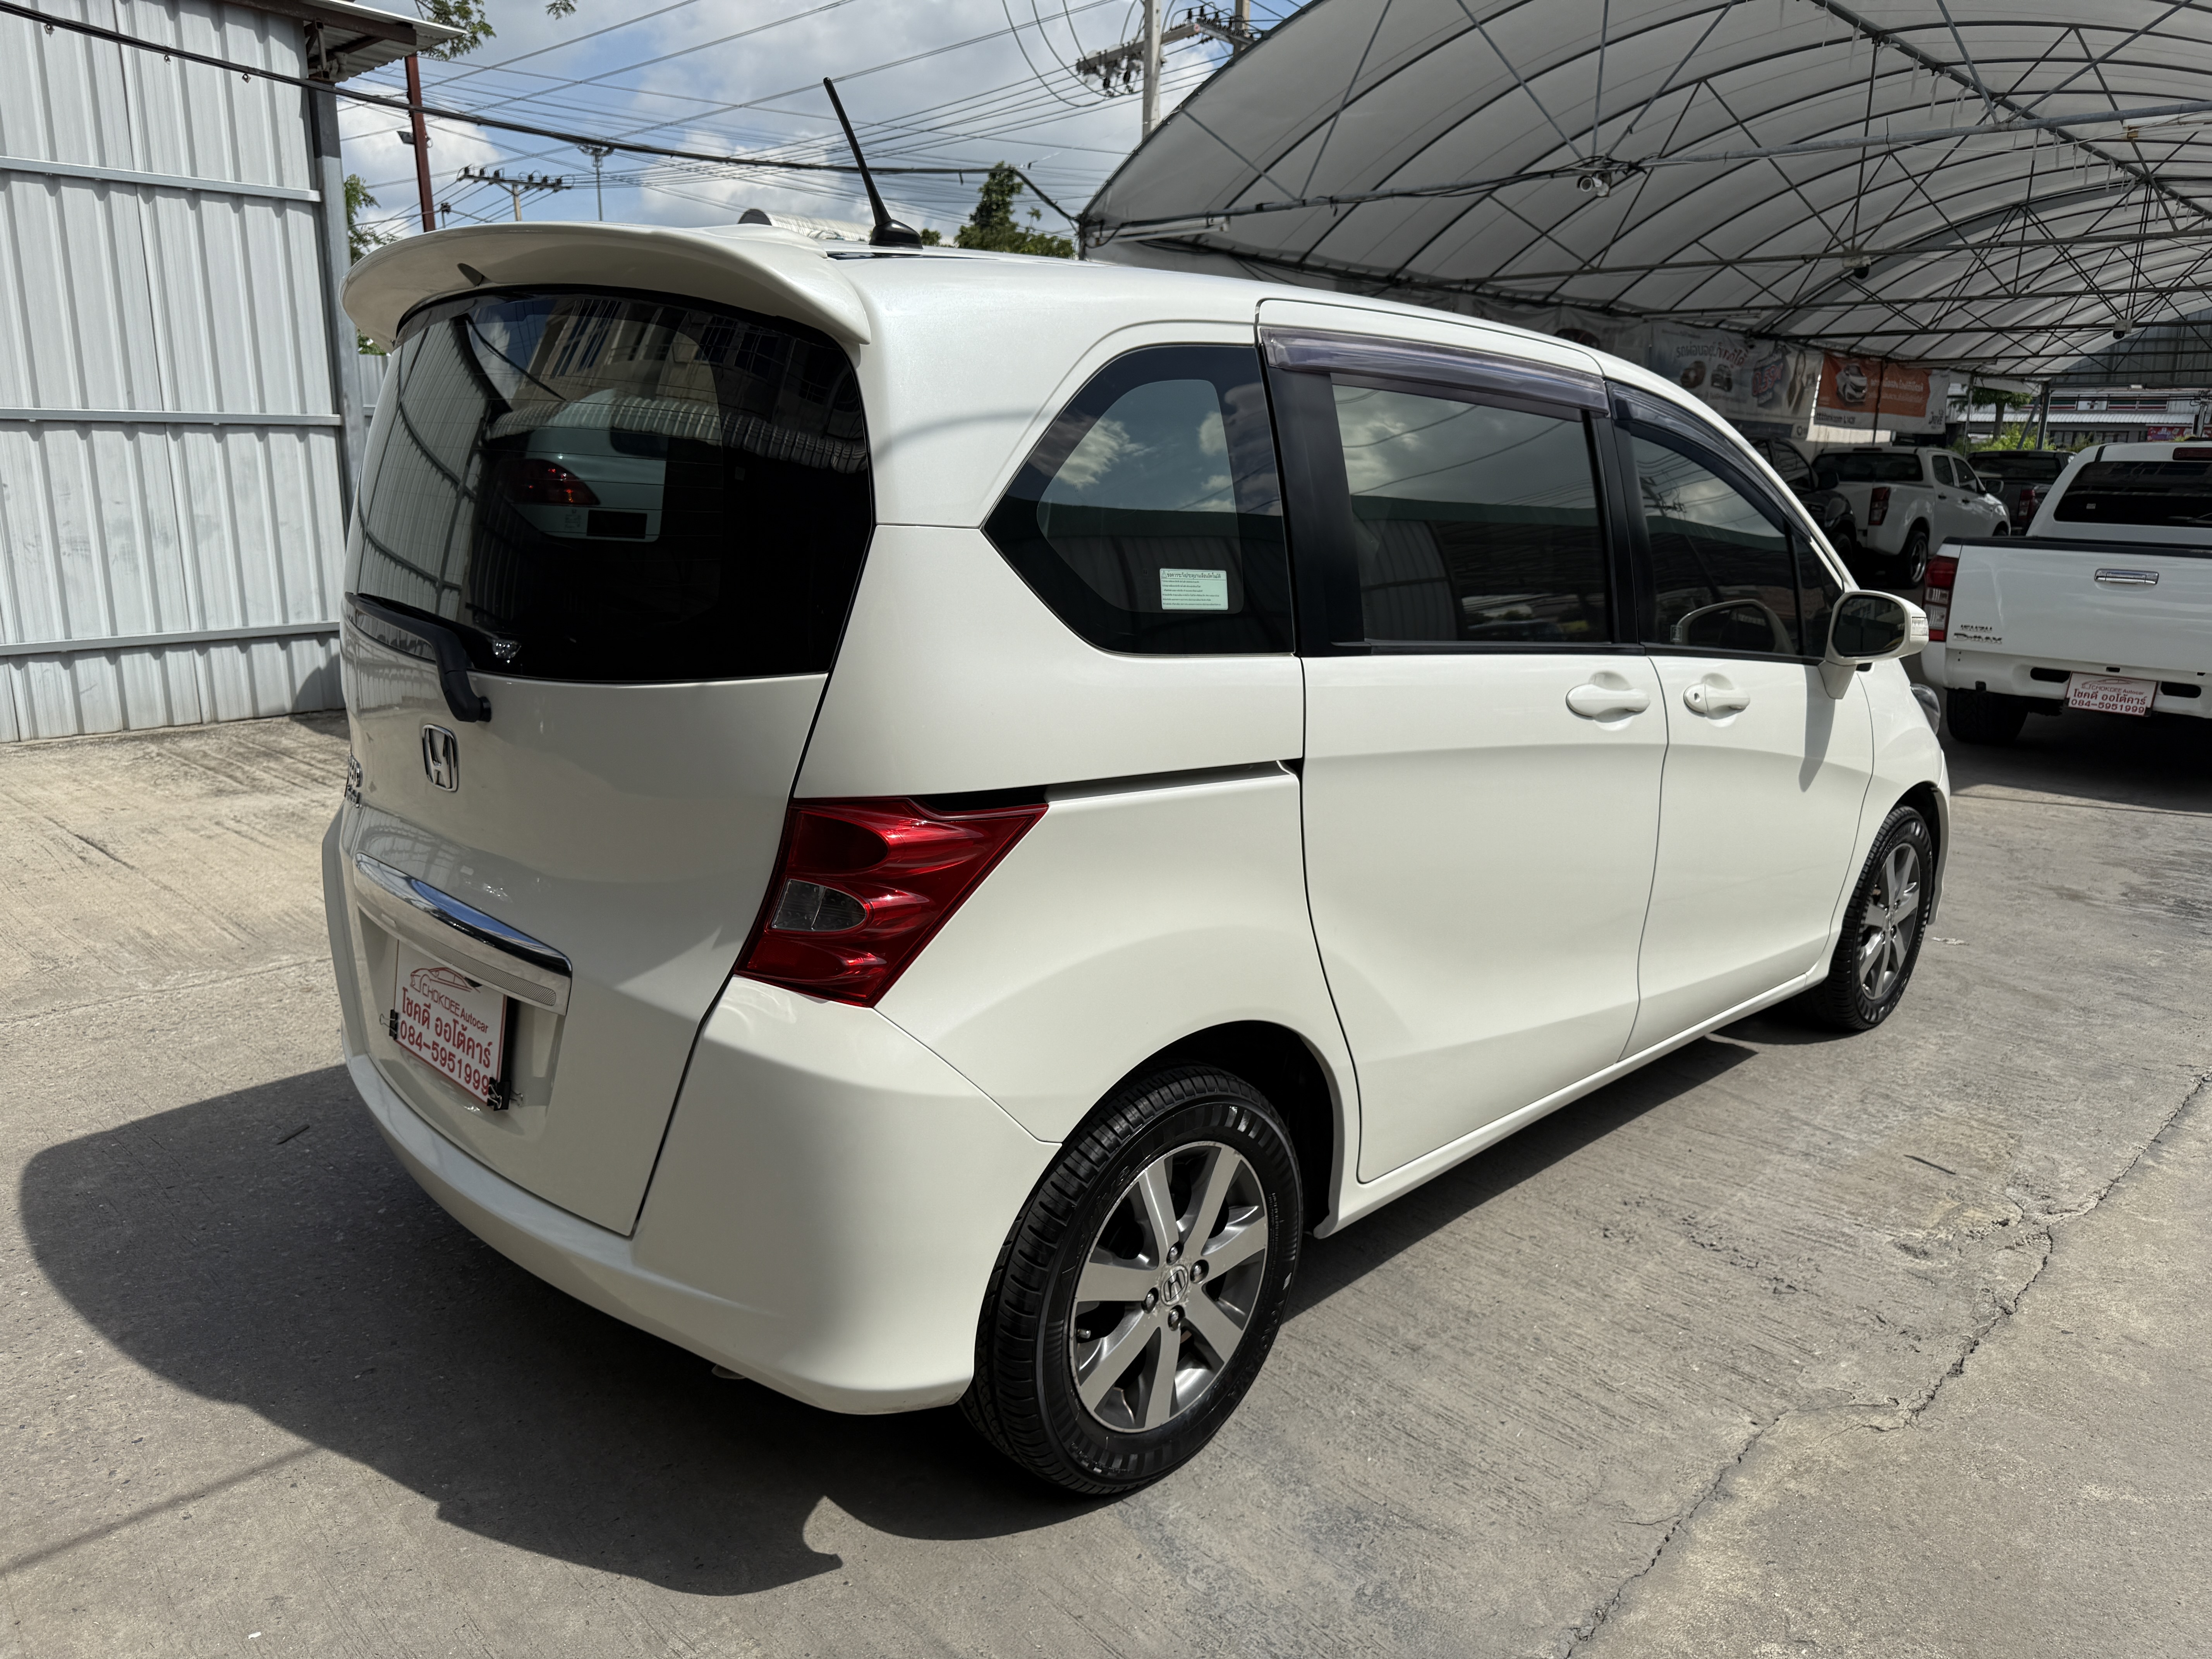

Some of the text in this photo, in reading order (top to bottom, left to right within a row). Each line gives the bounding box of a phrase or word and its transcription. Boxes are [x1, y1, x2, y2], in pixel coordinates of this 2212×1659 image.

[1960, 624, 1992, 632] ISUZU
[2071, 699, 2145, 714] 084-5951999
[2073, 689, 2148, 705] โชคดี ออโต้คาร์
[422, 982, 489, 1034] CHOKDEE Autocar
[402, 986, 493, 1068] โชคดี ออโต้คาร์
[400, 1020, 489, 1096] 084-5951999
